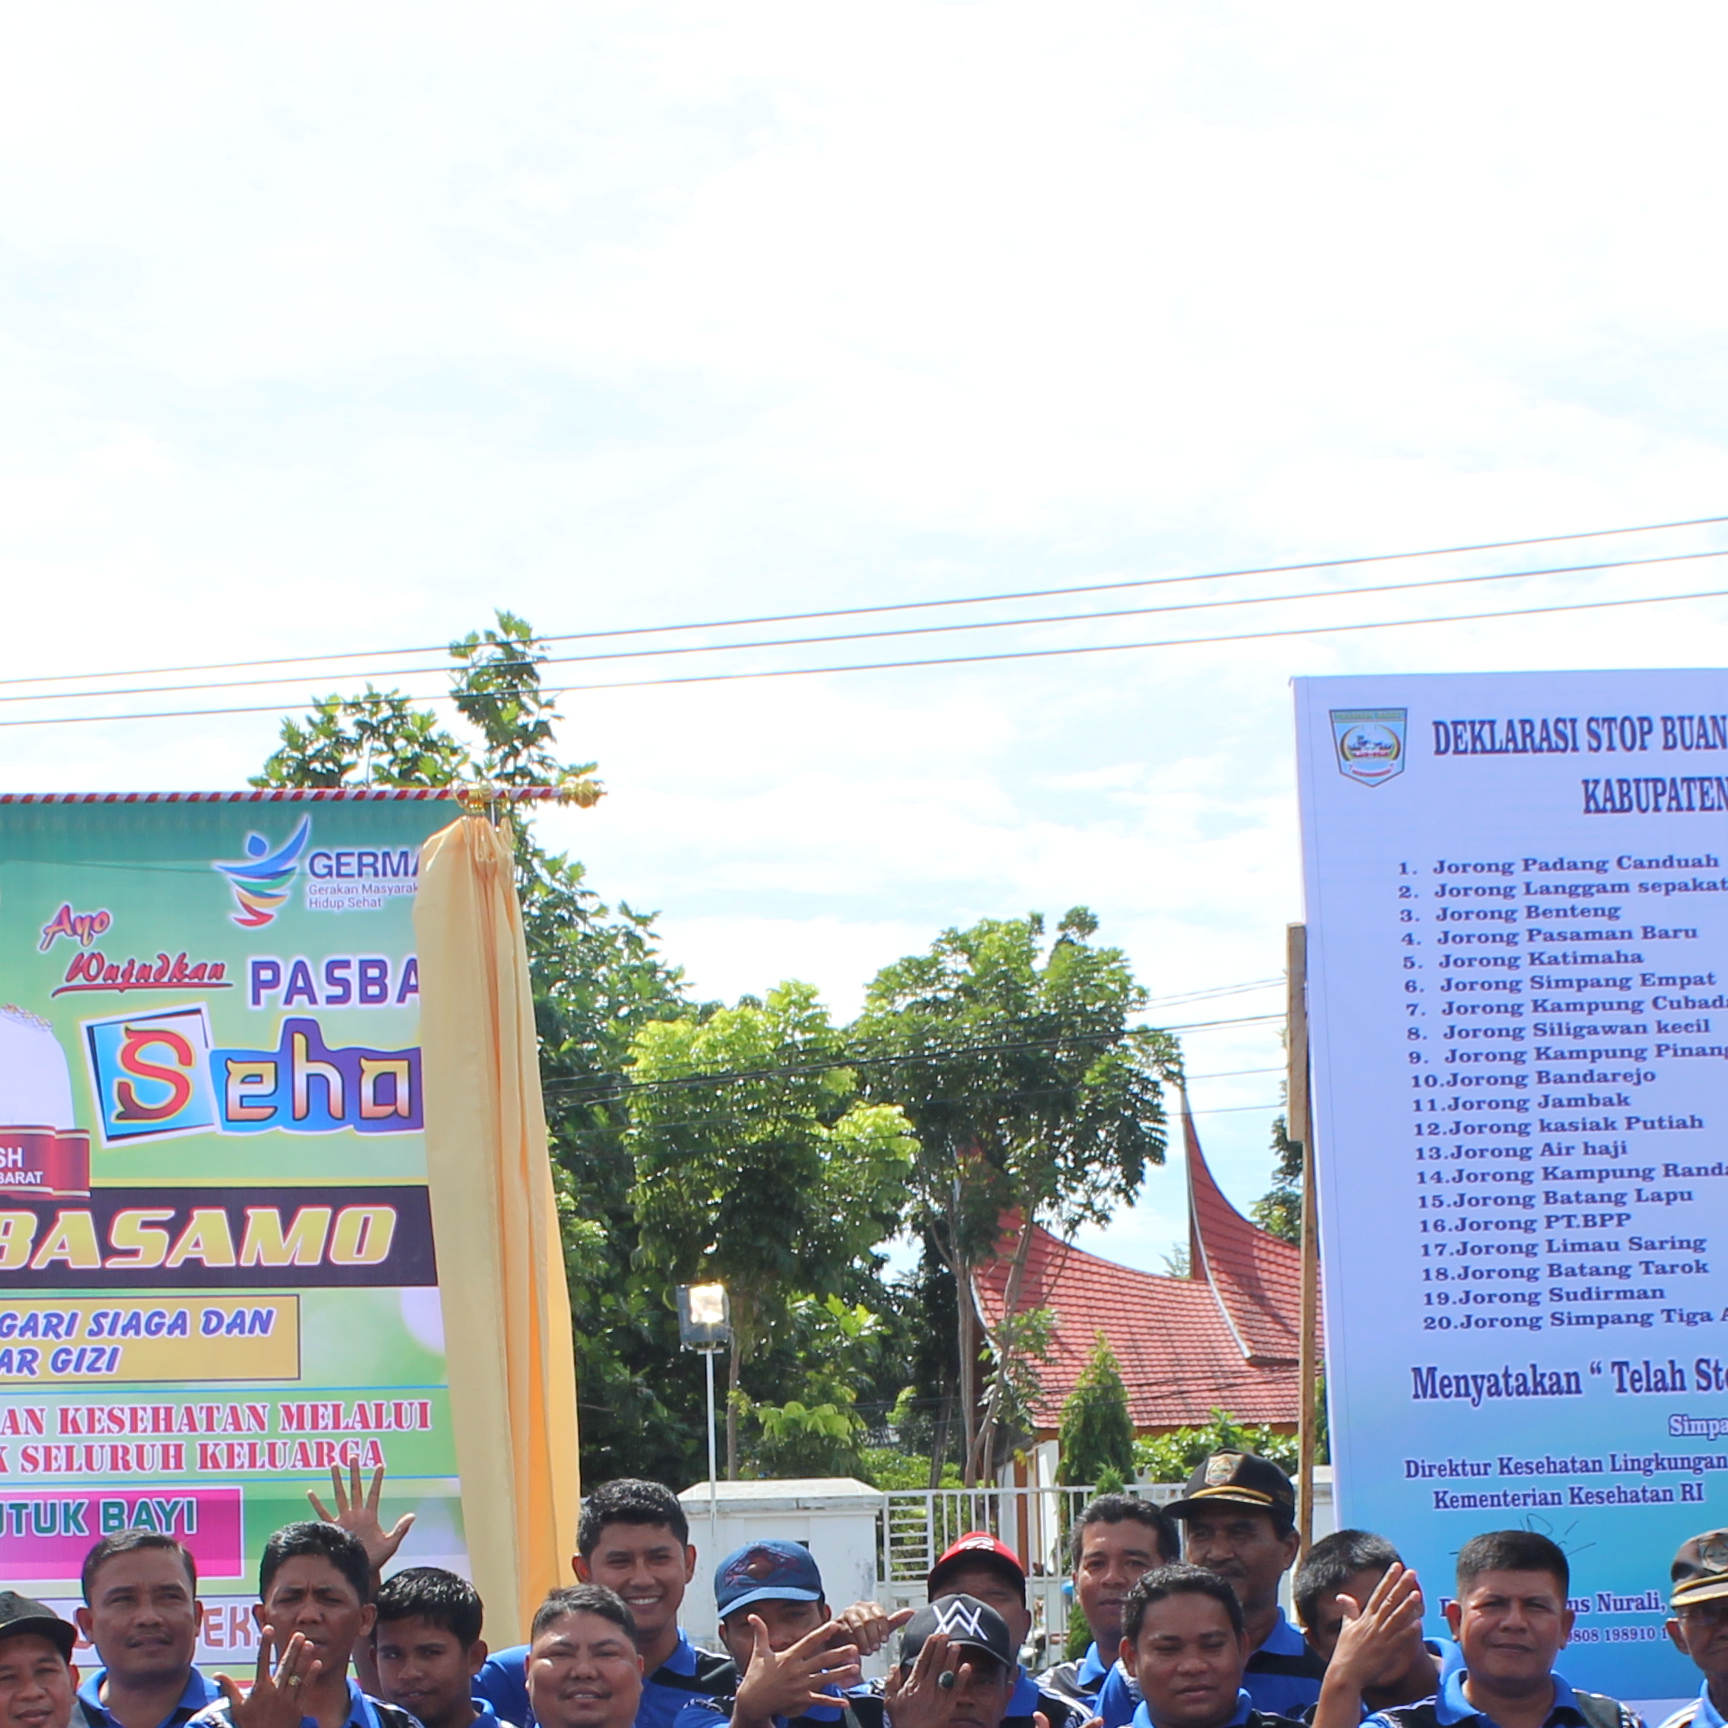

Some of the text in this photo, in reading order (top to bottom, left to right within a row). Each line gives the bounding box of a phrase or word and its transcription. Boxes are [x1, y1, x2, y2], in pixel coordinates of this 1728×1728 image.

[1432, 716, 1578, 756] DEKLARASI
[1586, 714, 1654, 752] STOP
[309, 897, 382, 911] Hidup Sehat
[1400, 905, 1621, 923] 3. Jorong Benteng
[39, 904, 112, 951] Ayo
[250, 957, 421, 1006] PASBA
[1406, 1003, 1426, 1016] 7.
[1441, 1001, 1524, 1018] Jorong
[1531, 999, 1645, 1016] Kampung
[1407, 1019, 1710, 1041] 8. Jorong Siligawan kecil
[111, 1025, 414, 1123] Seha
[87, 1309, 189, 1339] SIAGA
[200, 1307, 276, 1336] DAN
[50, 1346, 121, 1374] GIZI
[1411, 1364, 1582, 1407] Menyatakan
[1612, 1361, 1686, 1396] Telah
[58, 1404, 269, 1435] KESEHATAN
[278, 1401, 432, 1432] MELALUI
[21, 1442, 185, 1474] SELURUH
[196, 1439, 385, 1471] KELUARGA
[1404, 1453, 1728, 1479] Direktur Kesehatan Lingkungan
[1433, 1483, 1704, 1510] Kementerian Kesehatan RI
[102, 1497, 198, 1536] BAYI
[1595, 1591, 1667, 1615] Nurali,
[1604, 1627, 1657, 1642] 198910
